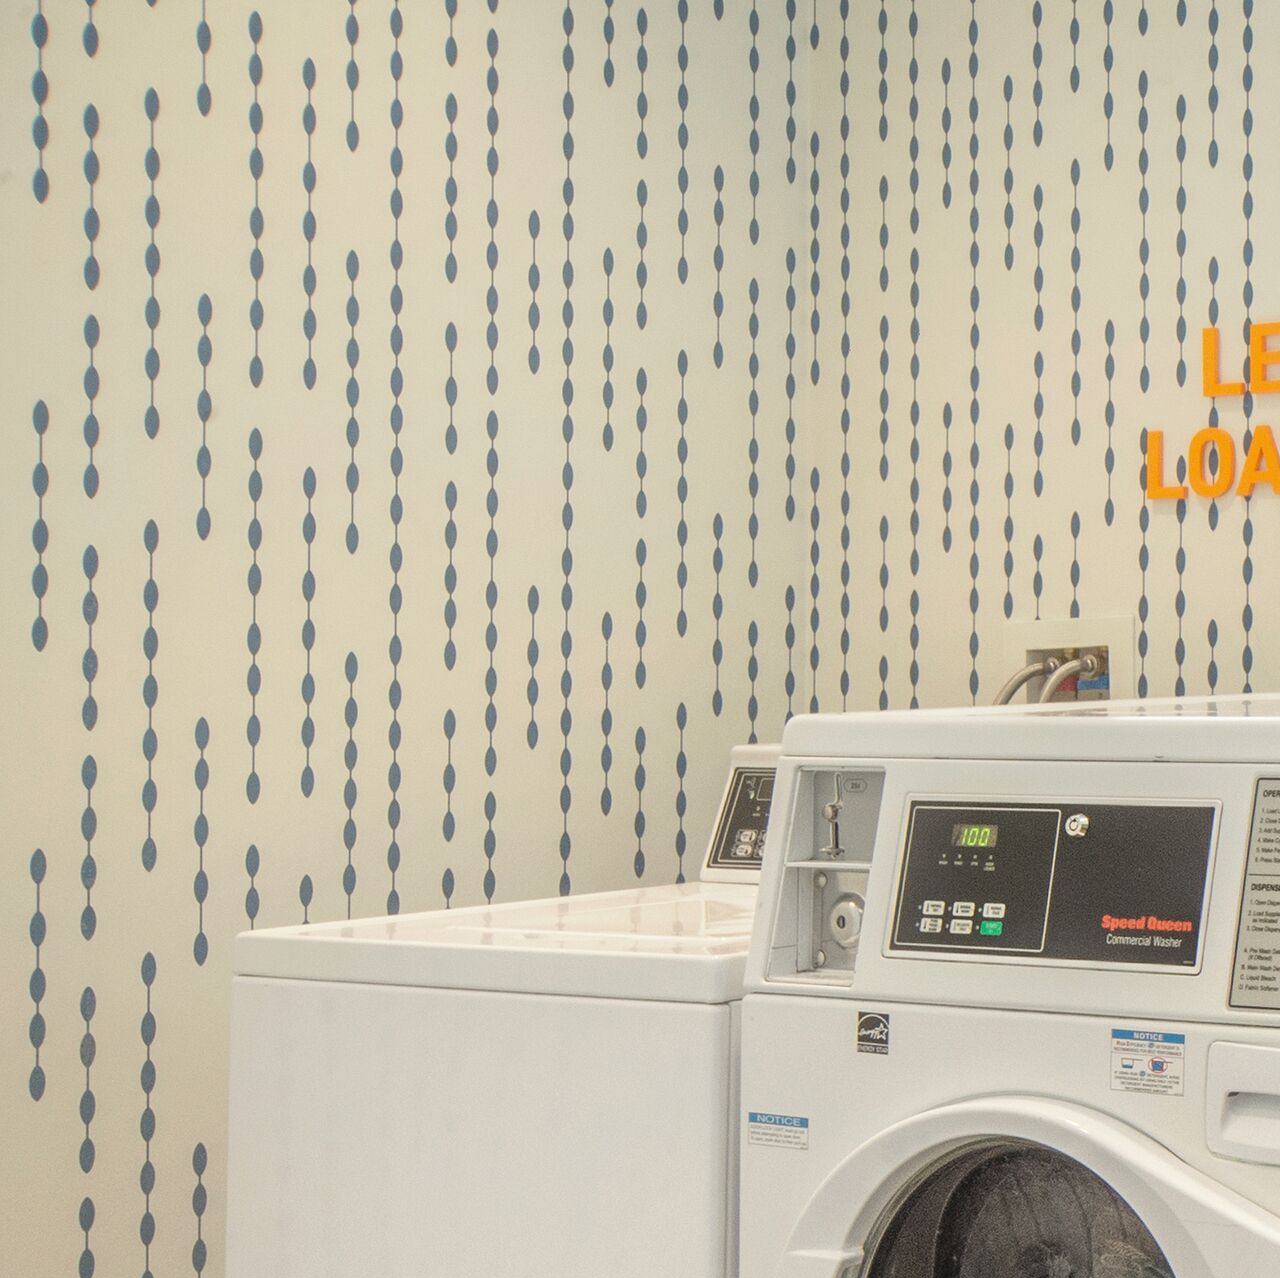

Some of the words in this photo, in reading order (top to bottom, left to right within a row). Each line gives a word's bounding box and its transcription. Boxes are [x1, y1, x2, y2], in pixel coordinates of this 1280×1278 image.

[961, 828, 990, 846] 100
[1101, 914, 1146, 932] Speed
[1147, 916, 1192, 931] Queen
[1106, 933, 1151, 946] Commercial
[1153, 936, 1182, 948] Washer
[1133, 1032, 1164, 1041] NOTICE
[757, 1114, 800, 1126] NOTICE
